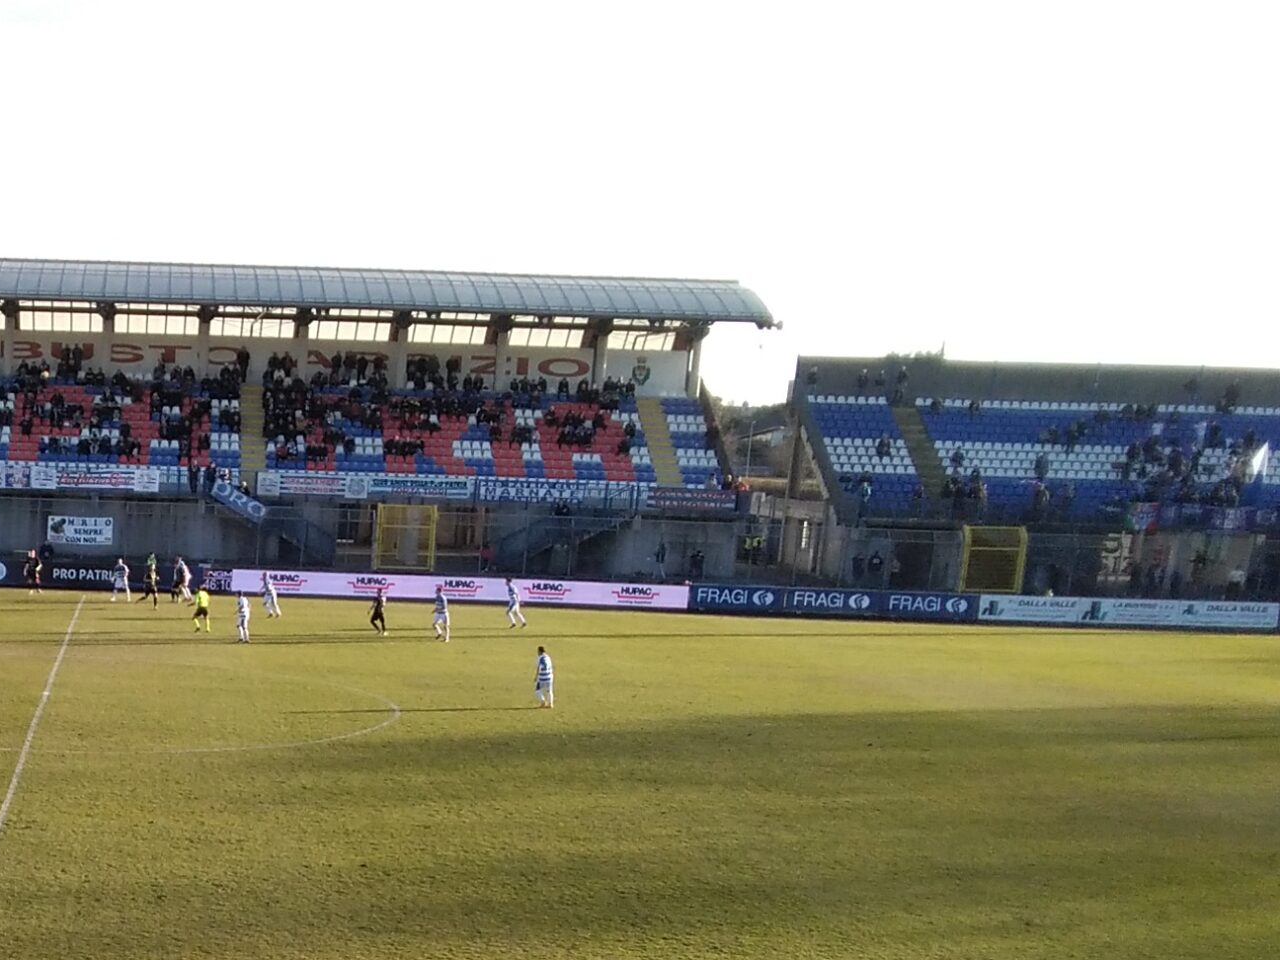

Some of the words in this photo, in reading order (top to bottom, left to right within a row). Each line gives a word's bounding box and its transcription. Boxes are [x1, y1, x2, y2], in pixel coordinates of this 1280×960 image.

[52, 568, 76, 580] PRO
[356, 577, 387, 586] HUPAC
[444, 580, 475, 590] HUPAC
[532, 583, 564, 592] HUPAC
[620, 587, 652, 596] HUPAC
[697, 587, 748, 605] FRAGI
[794, 591, 845, 609] FRAGI
[889, 595, 941, 613] FRAGI
